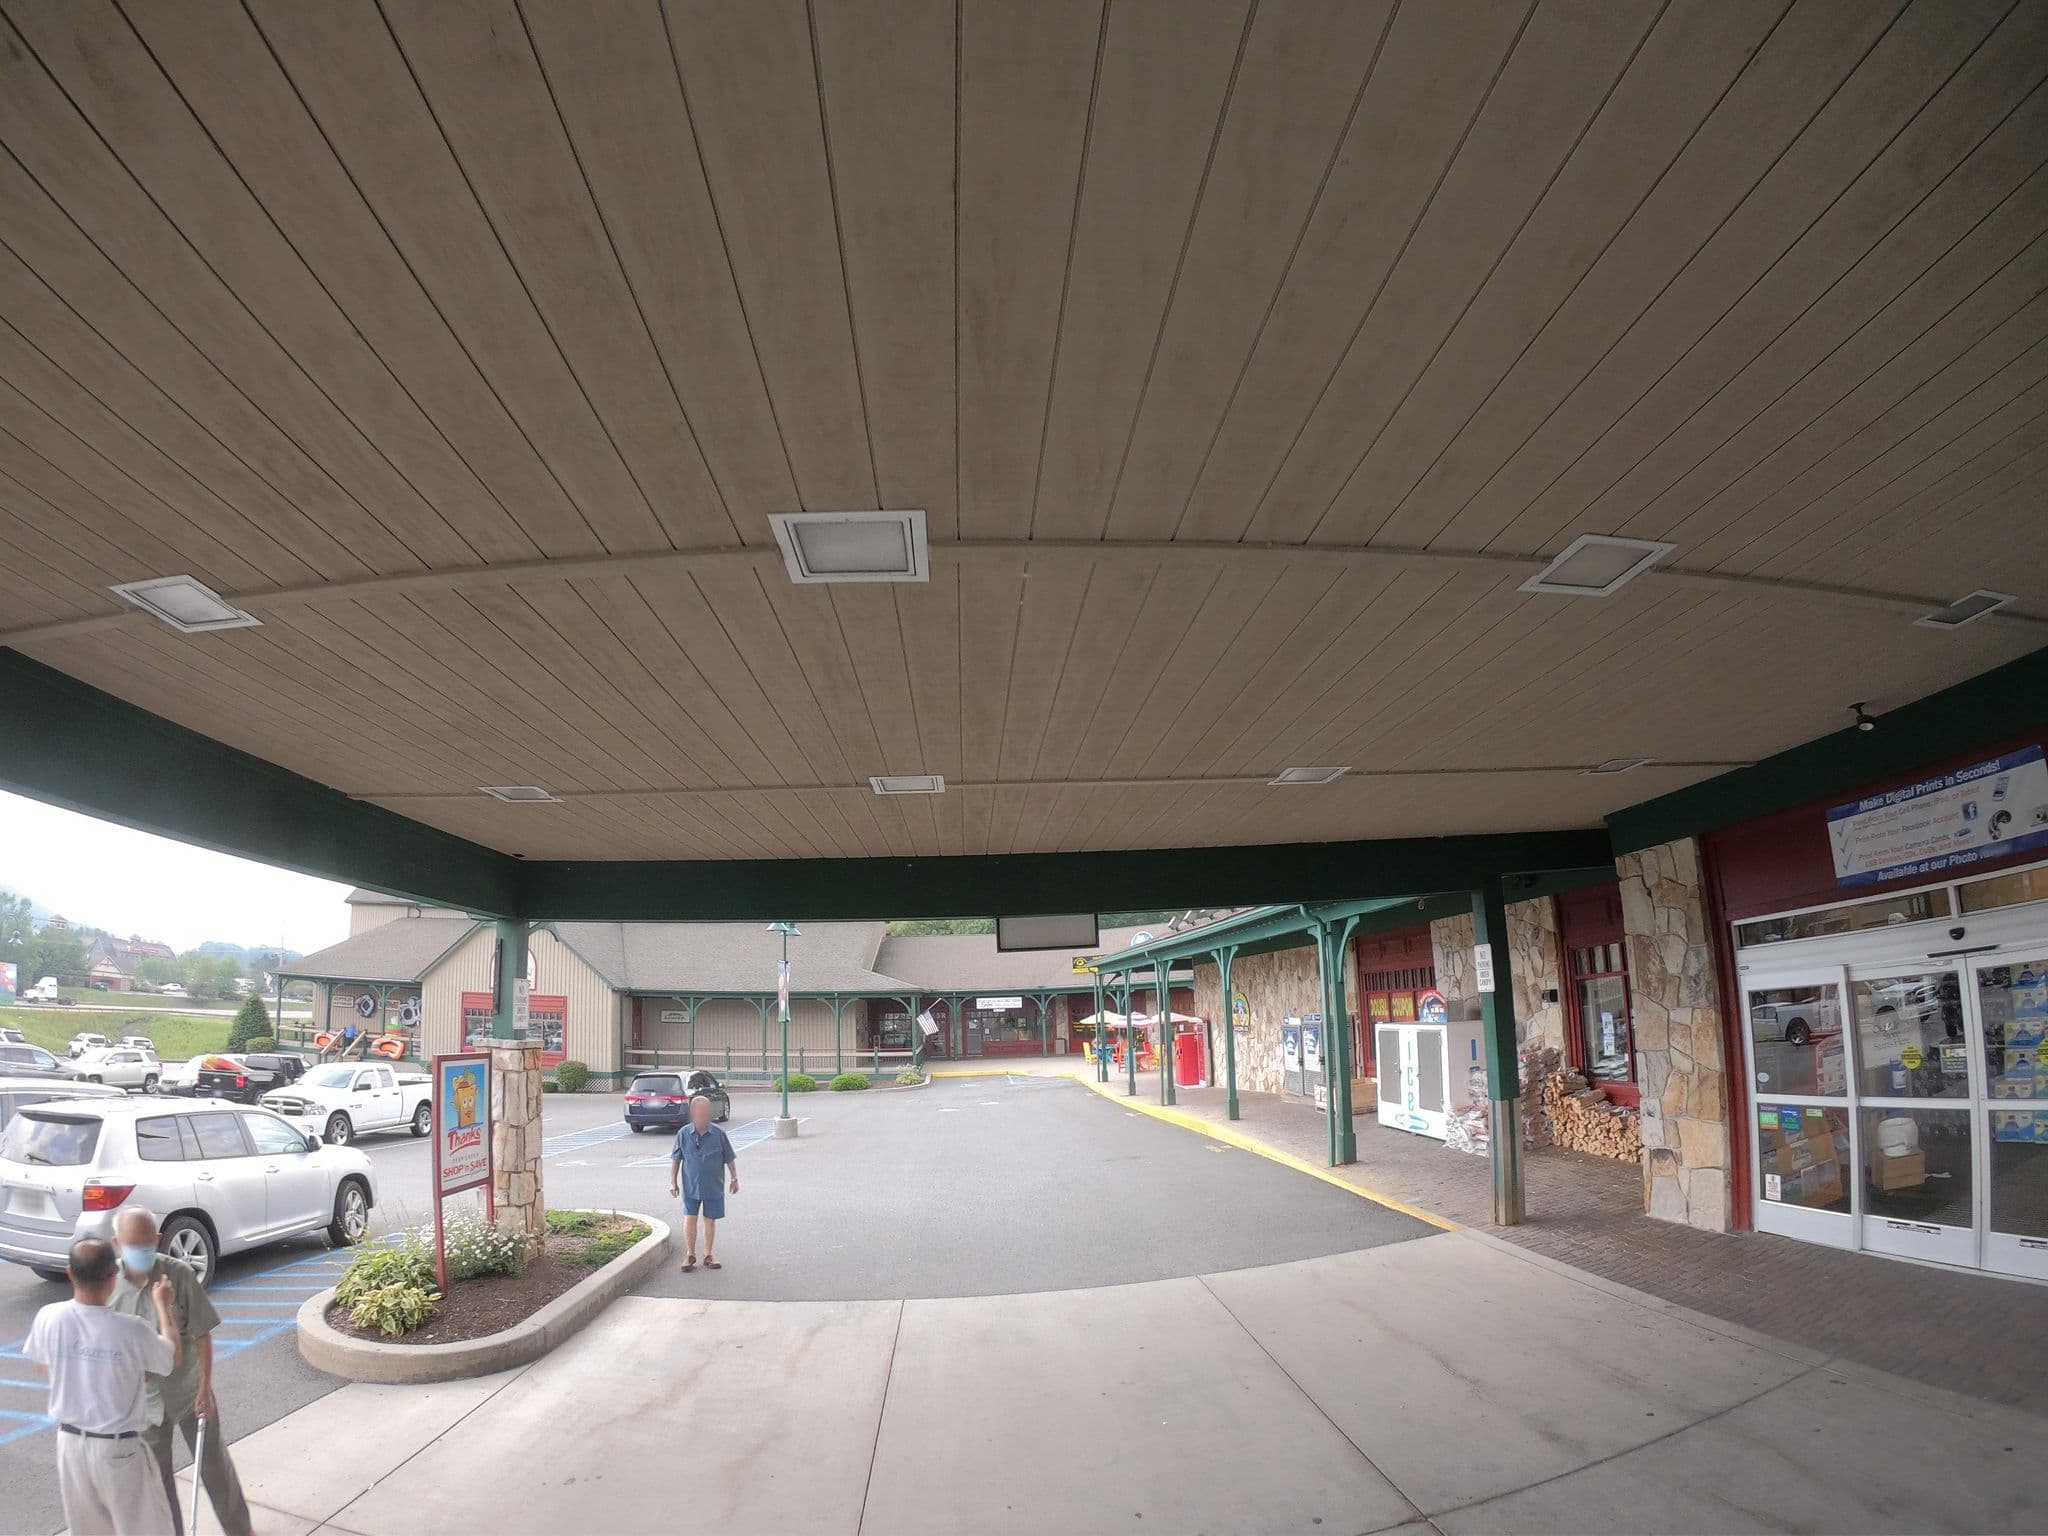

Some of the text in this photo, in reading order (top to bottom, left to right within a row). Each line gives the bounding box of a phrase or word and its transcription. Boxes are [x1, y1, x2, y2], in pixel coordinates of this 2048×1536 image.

[1858, 797, 1884, 812] Make
[1885, 787, 1915, 804] Digital
[1916, 779, 1944, 796] Prints
[1944, 775, 1955, 786] in
[1955, 759, 2001, 783] Seconds!
[1876, 850, 1978, 882] Available at our Photo
[447, 1127, 481, 1151] Thanks
[443, 1164, 464, 1178] SHOP
[470, 1157, 488, 1171] SAVE
